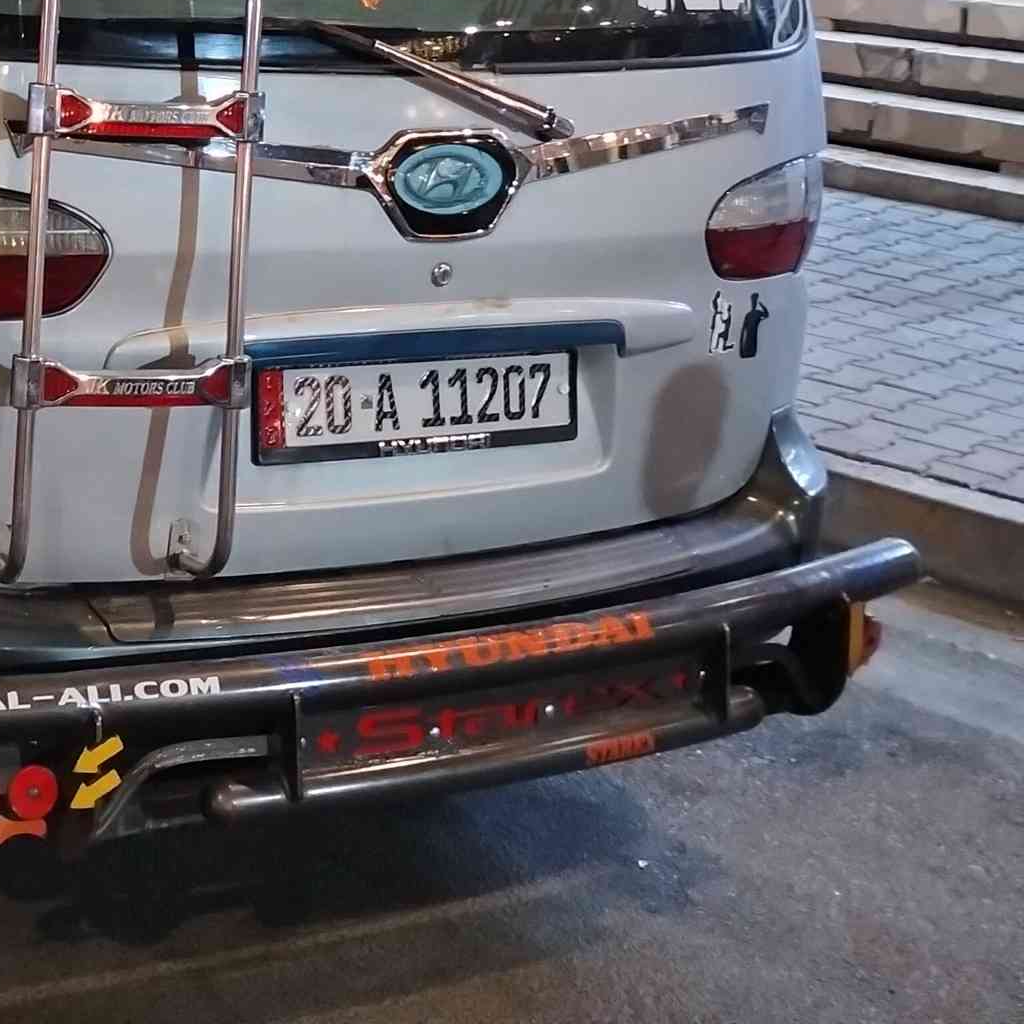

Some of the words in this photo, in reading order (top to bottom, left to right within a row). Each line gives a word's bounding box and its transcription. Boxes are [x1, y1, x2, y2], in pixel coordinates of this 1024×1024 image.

[114, 380, 164, 395] MOTORS
[166, 380, 196, 394] CLUB
[294, 374, 352, 437] 20
[374, 373, 400, 432] A
[418, 363, 551, 428] 11207
[367, 611, 655, 681] HYUNDAI
